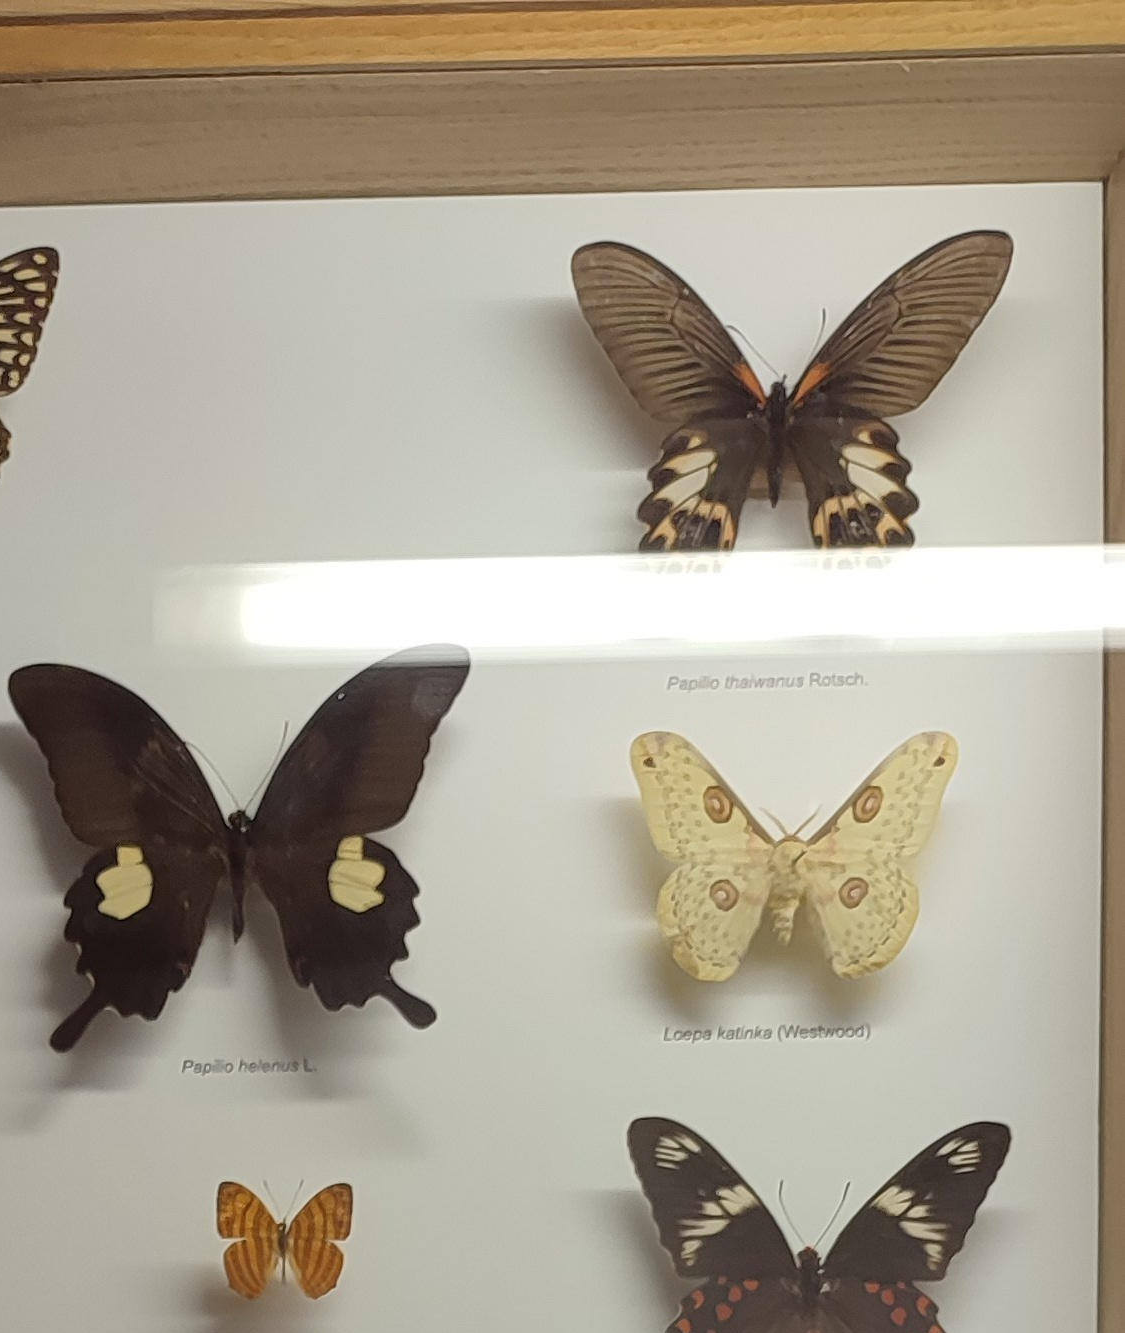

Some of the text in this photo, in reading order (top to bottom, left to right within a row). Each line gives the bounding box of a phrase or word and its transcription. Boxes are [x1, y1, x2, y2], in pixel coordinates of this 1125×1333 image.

[667, 676, 719, 692] Papilio
[725, 675, 804, 689] thaiwanus
[664, 1024, 870, 1043] Loepa katinka (Westwood)
[181, 1059, 317, 1076] Papilio helenus L.
